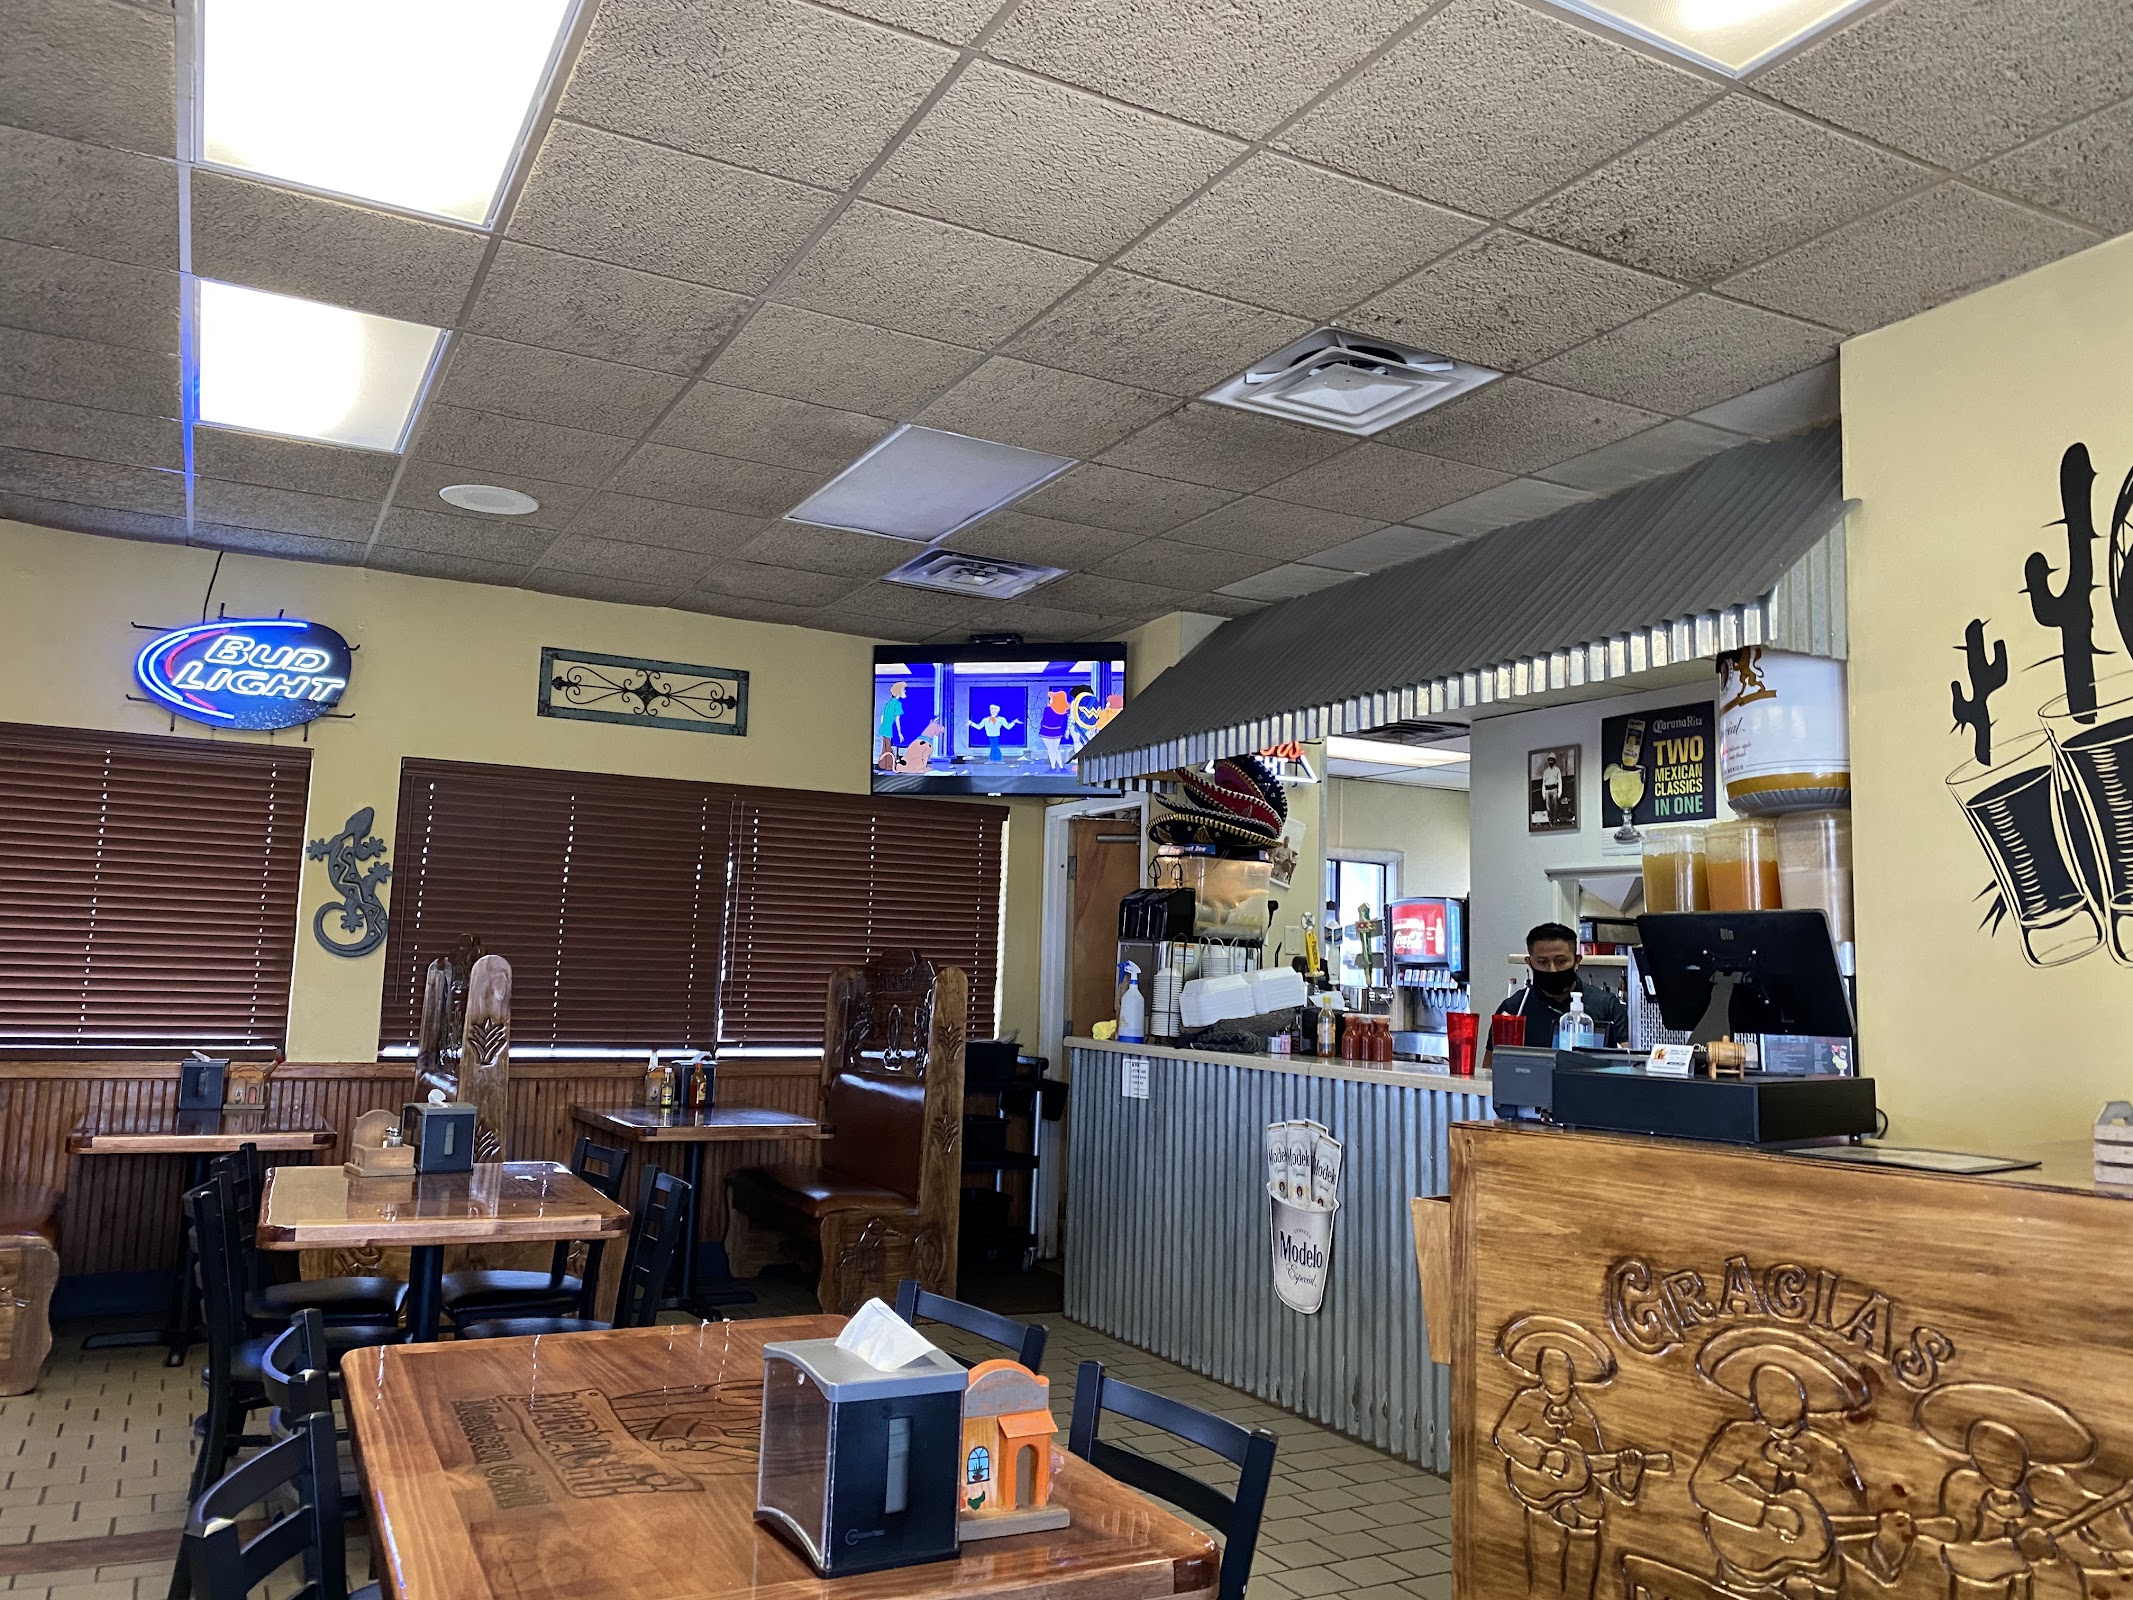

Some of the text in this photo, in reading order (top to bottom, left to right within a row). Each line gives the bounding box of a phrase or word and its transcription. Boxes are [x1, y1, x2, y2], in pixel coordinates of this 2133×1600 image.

[204, 634, 331, 674] BUD
[171, 662, 346, 701] LIGHT
[1652, 735, 1704, 766] TWO
[1654, 763, 1703, 782] MEXICAN
[1654, 777, 1703, 797] CLASSICS
[1654, 795, 1704, 816] IN ONE
[1279, 1229, 1323, 1268] Modelo
[1604, 1253, 1955, 1390] GRACIAS
